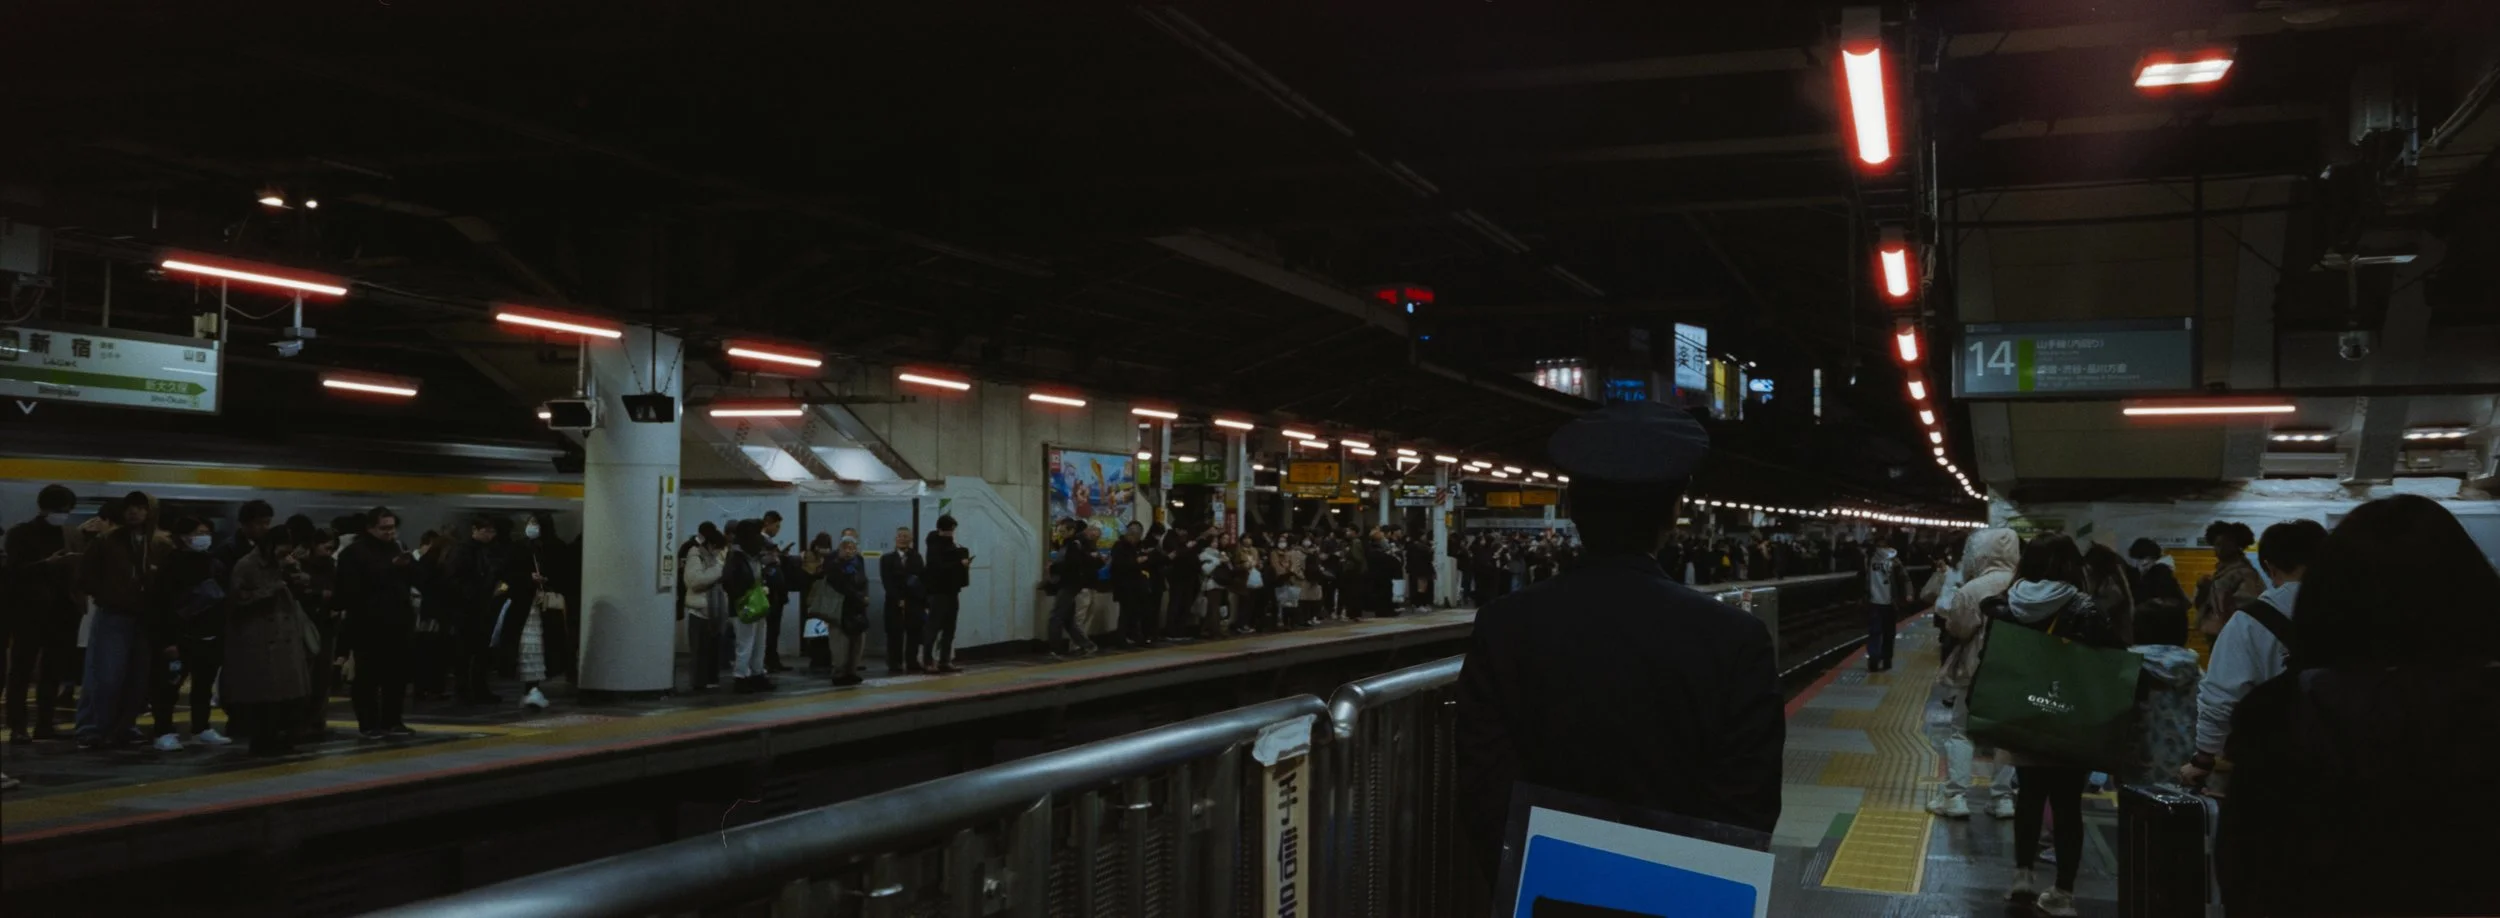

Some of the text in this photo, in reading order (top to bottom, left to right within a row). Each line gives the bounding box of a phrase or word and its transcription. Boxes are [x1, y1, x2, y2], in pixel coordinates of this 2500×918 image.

[29, 333, 91, 357] 新宿
[1969, 340, 2016, 377] 14
[1203, 463, 1221, 481] 15
[665, 498, 674, 552] しんじゅく
